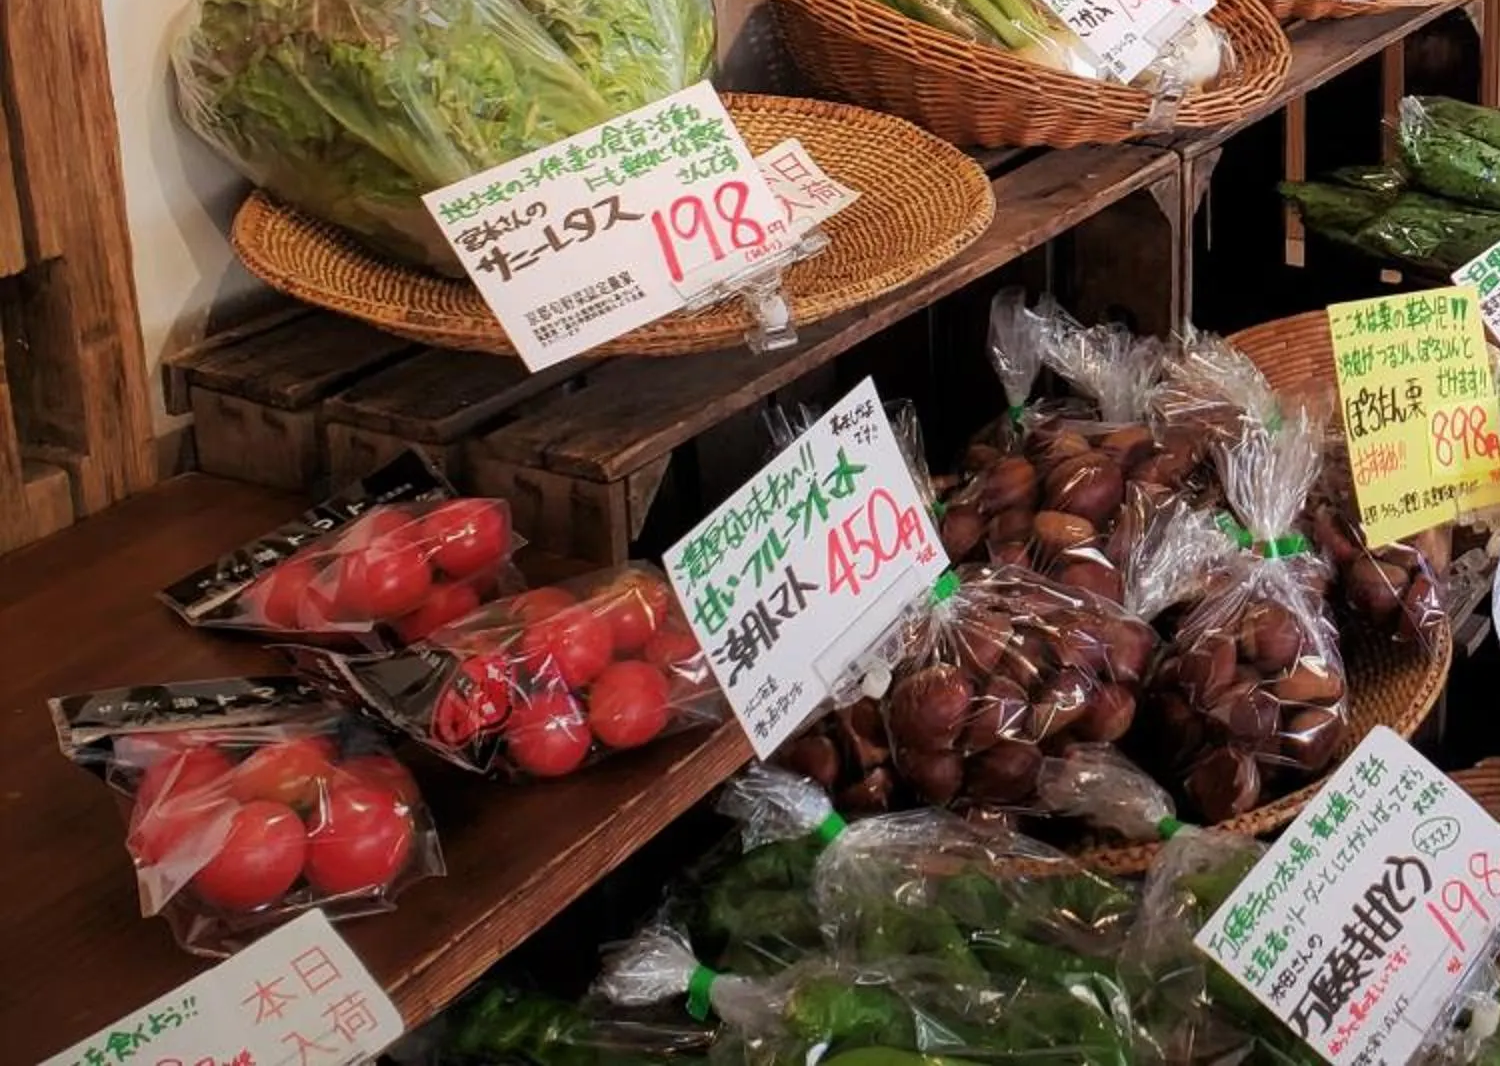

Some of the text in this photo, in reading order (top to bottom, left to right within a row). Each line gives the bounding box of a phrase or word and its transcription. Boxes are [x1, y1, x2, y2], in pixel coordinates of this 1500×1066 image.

[475, 194, 646, 283] サニーレタス
[1287, 854, 1434, 1038] 万願寺甘とう
